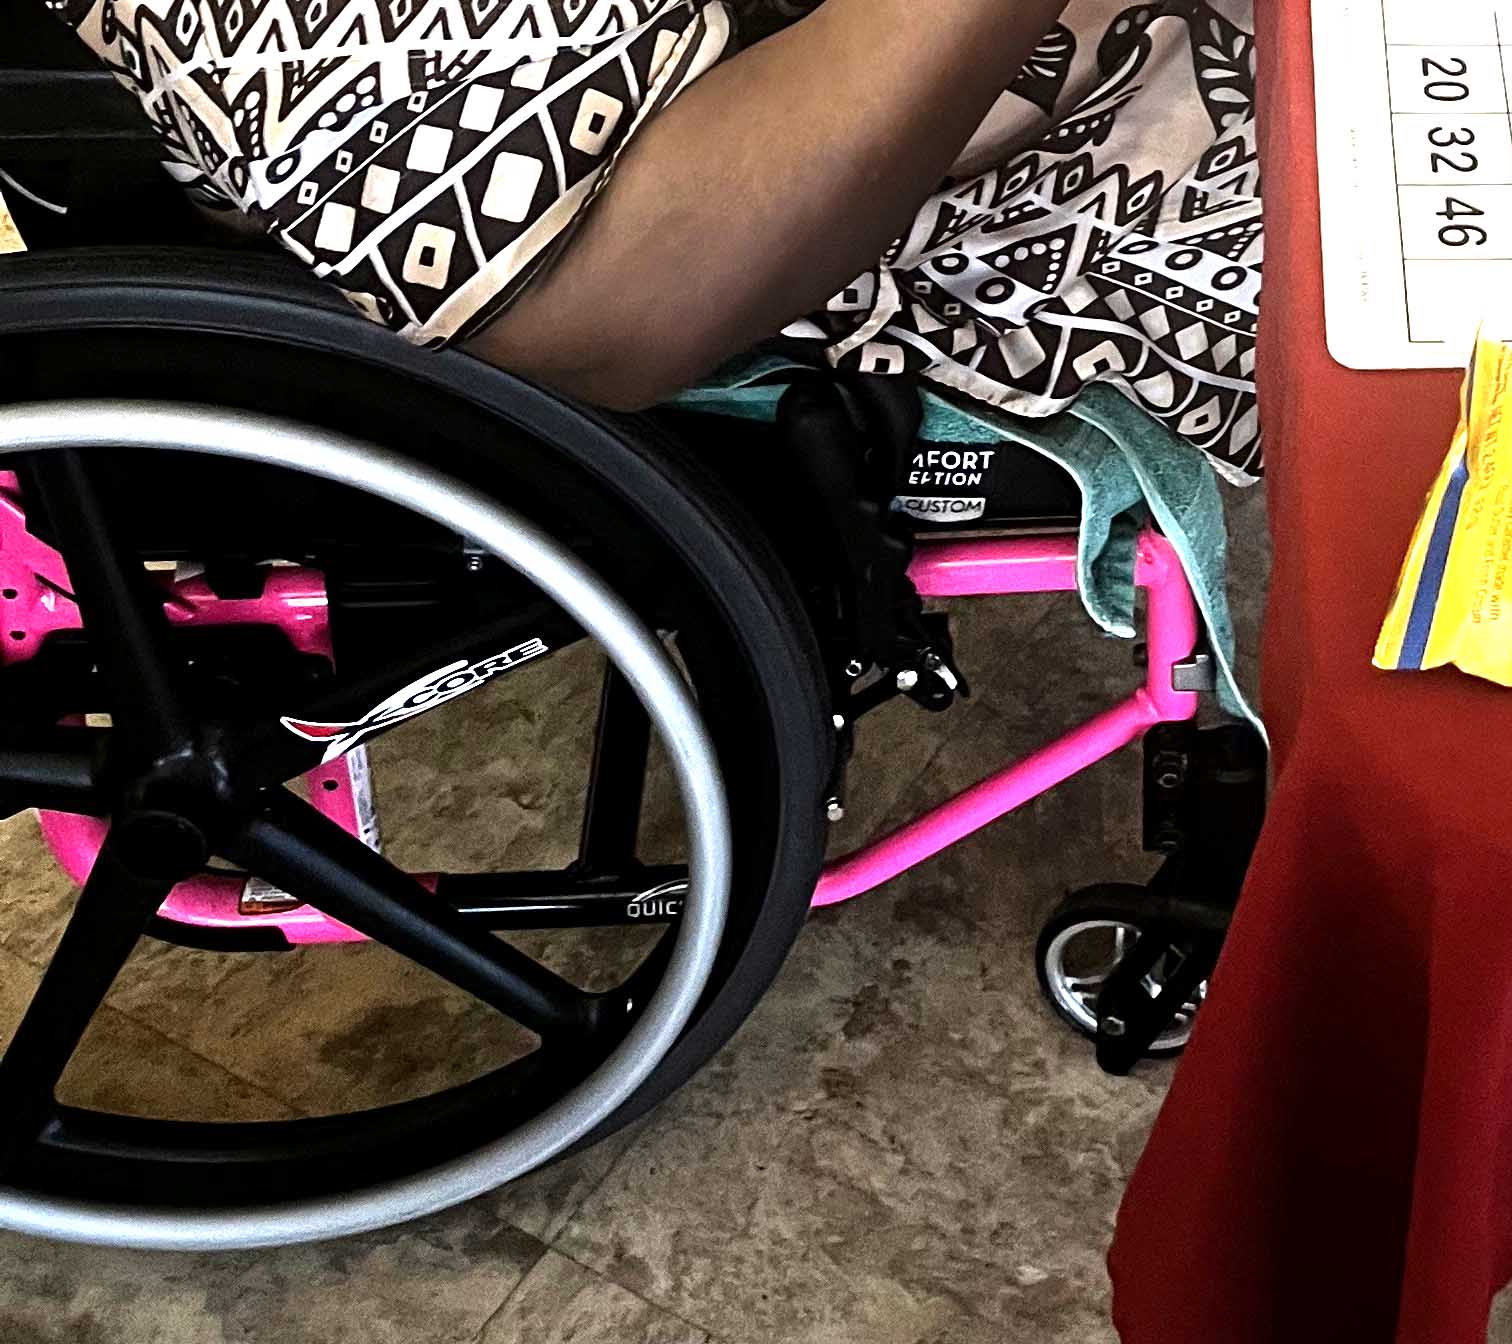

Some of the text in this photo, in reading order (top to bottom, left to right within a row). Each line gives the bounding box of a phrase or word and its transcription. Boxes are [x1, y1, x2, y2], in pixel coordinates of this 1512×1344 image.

[1420, 57, 1488, 247] 20 32 46
[905, 498, 982, 513] CUSTOM
[627, 900, 683, 918] QUIC
